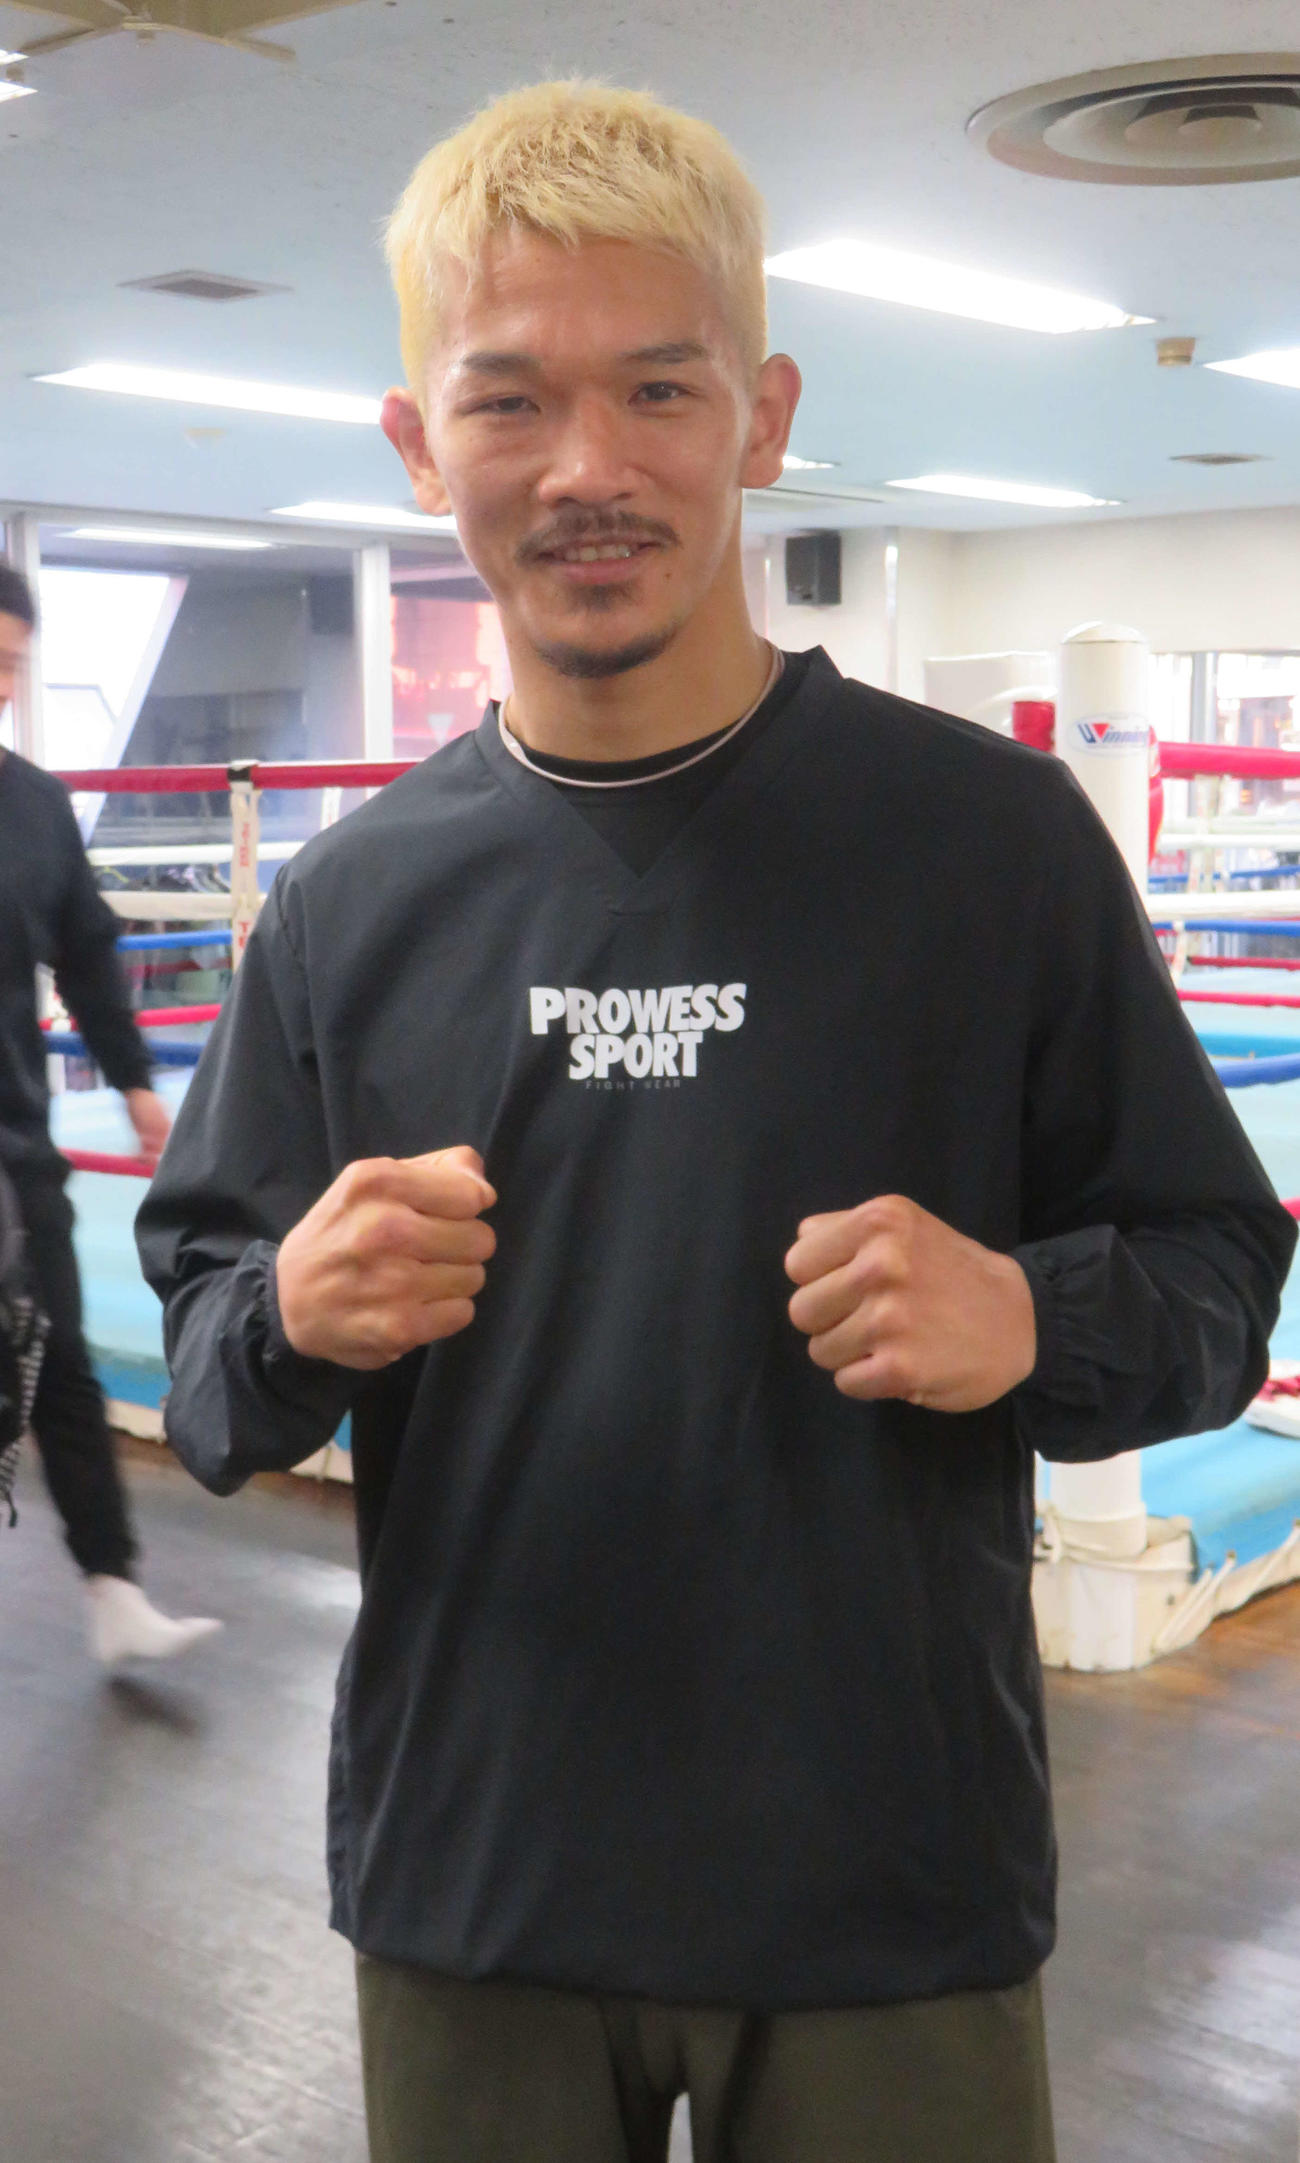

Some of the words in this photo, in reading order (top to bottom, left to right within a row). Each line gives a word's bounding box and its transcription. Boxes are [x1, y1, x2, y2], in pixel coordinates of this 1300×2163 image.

[529, 982, 747, 1035] PROWESS
[568, 1031, 704, 1080] SPORT
[585, 1080, 635, 1091] FIGHT
